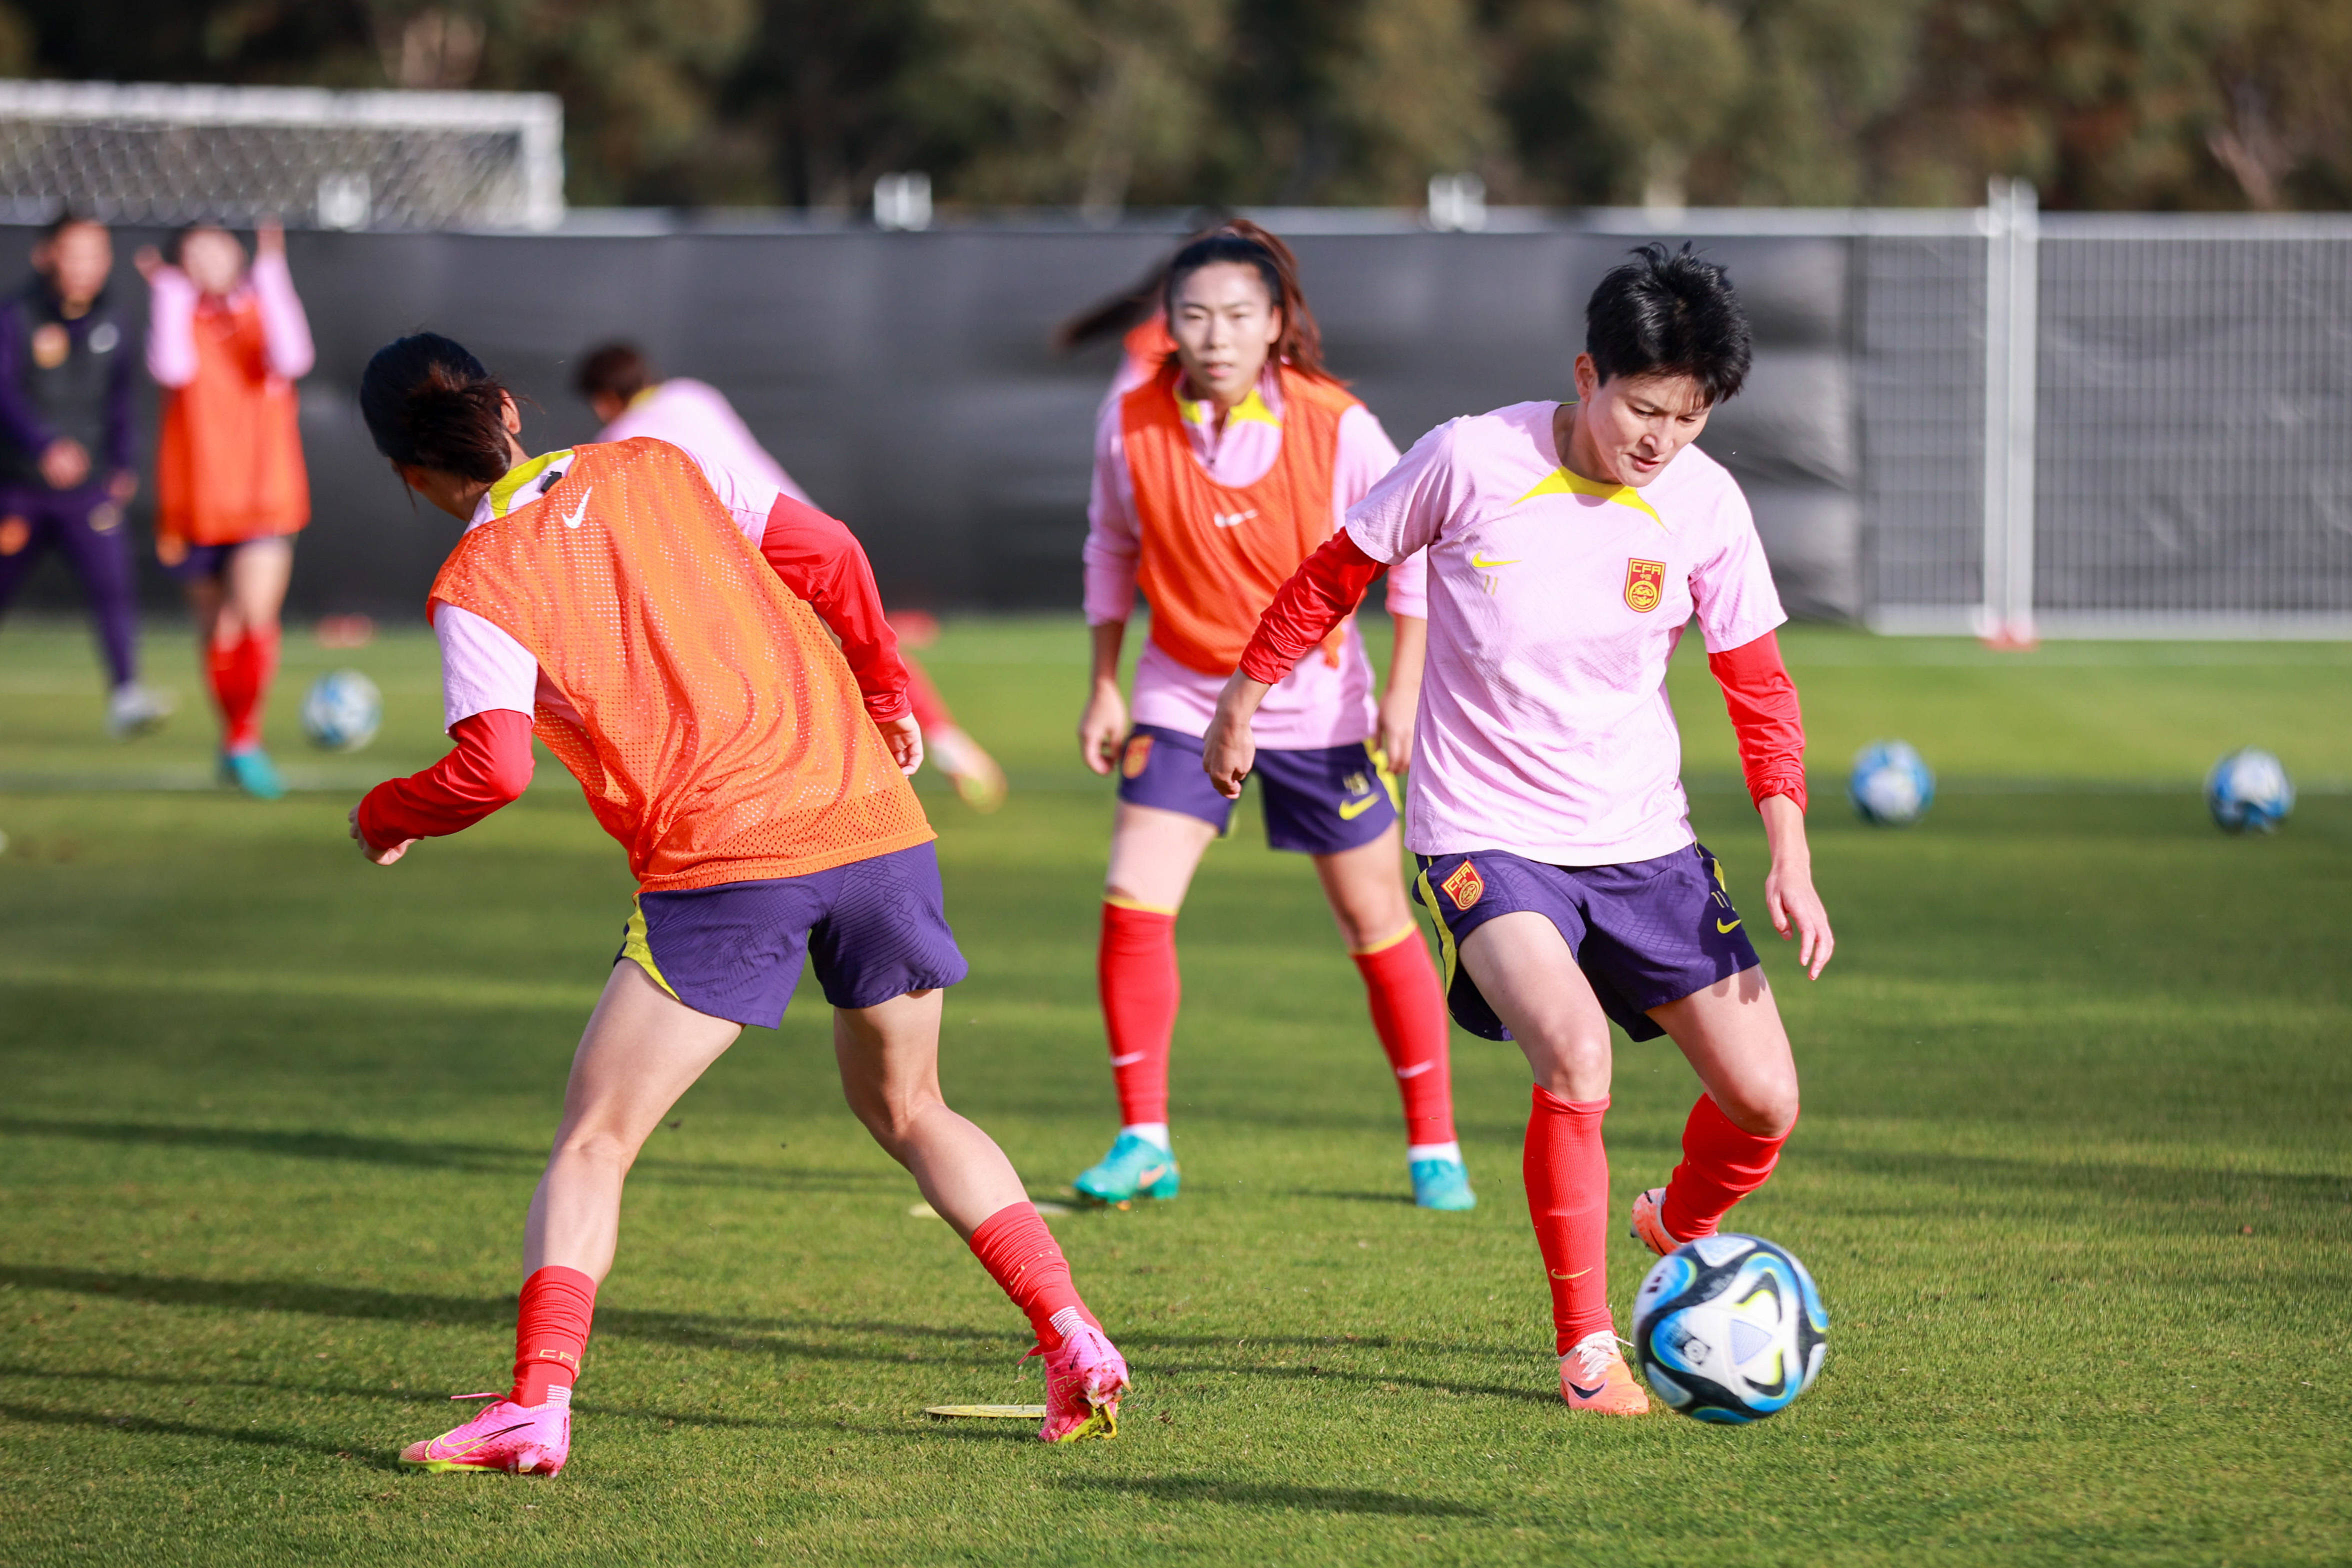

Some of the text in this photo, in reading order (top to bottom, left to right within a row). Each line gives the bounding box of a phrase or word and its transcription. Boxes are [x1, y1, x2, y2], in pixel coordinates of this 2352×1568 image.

[1632, 563, 1662, 576] CFA
[1482, 574, 1499, 596] 11
[1448, 866, 1470, 892] CFA
